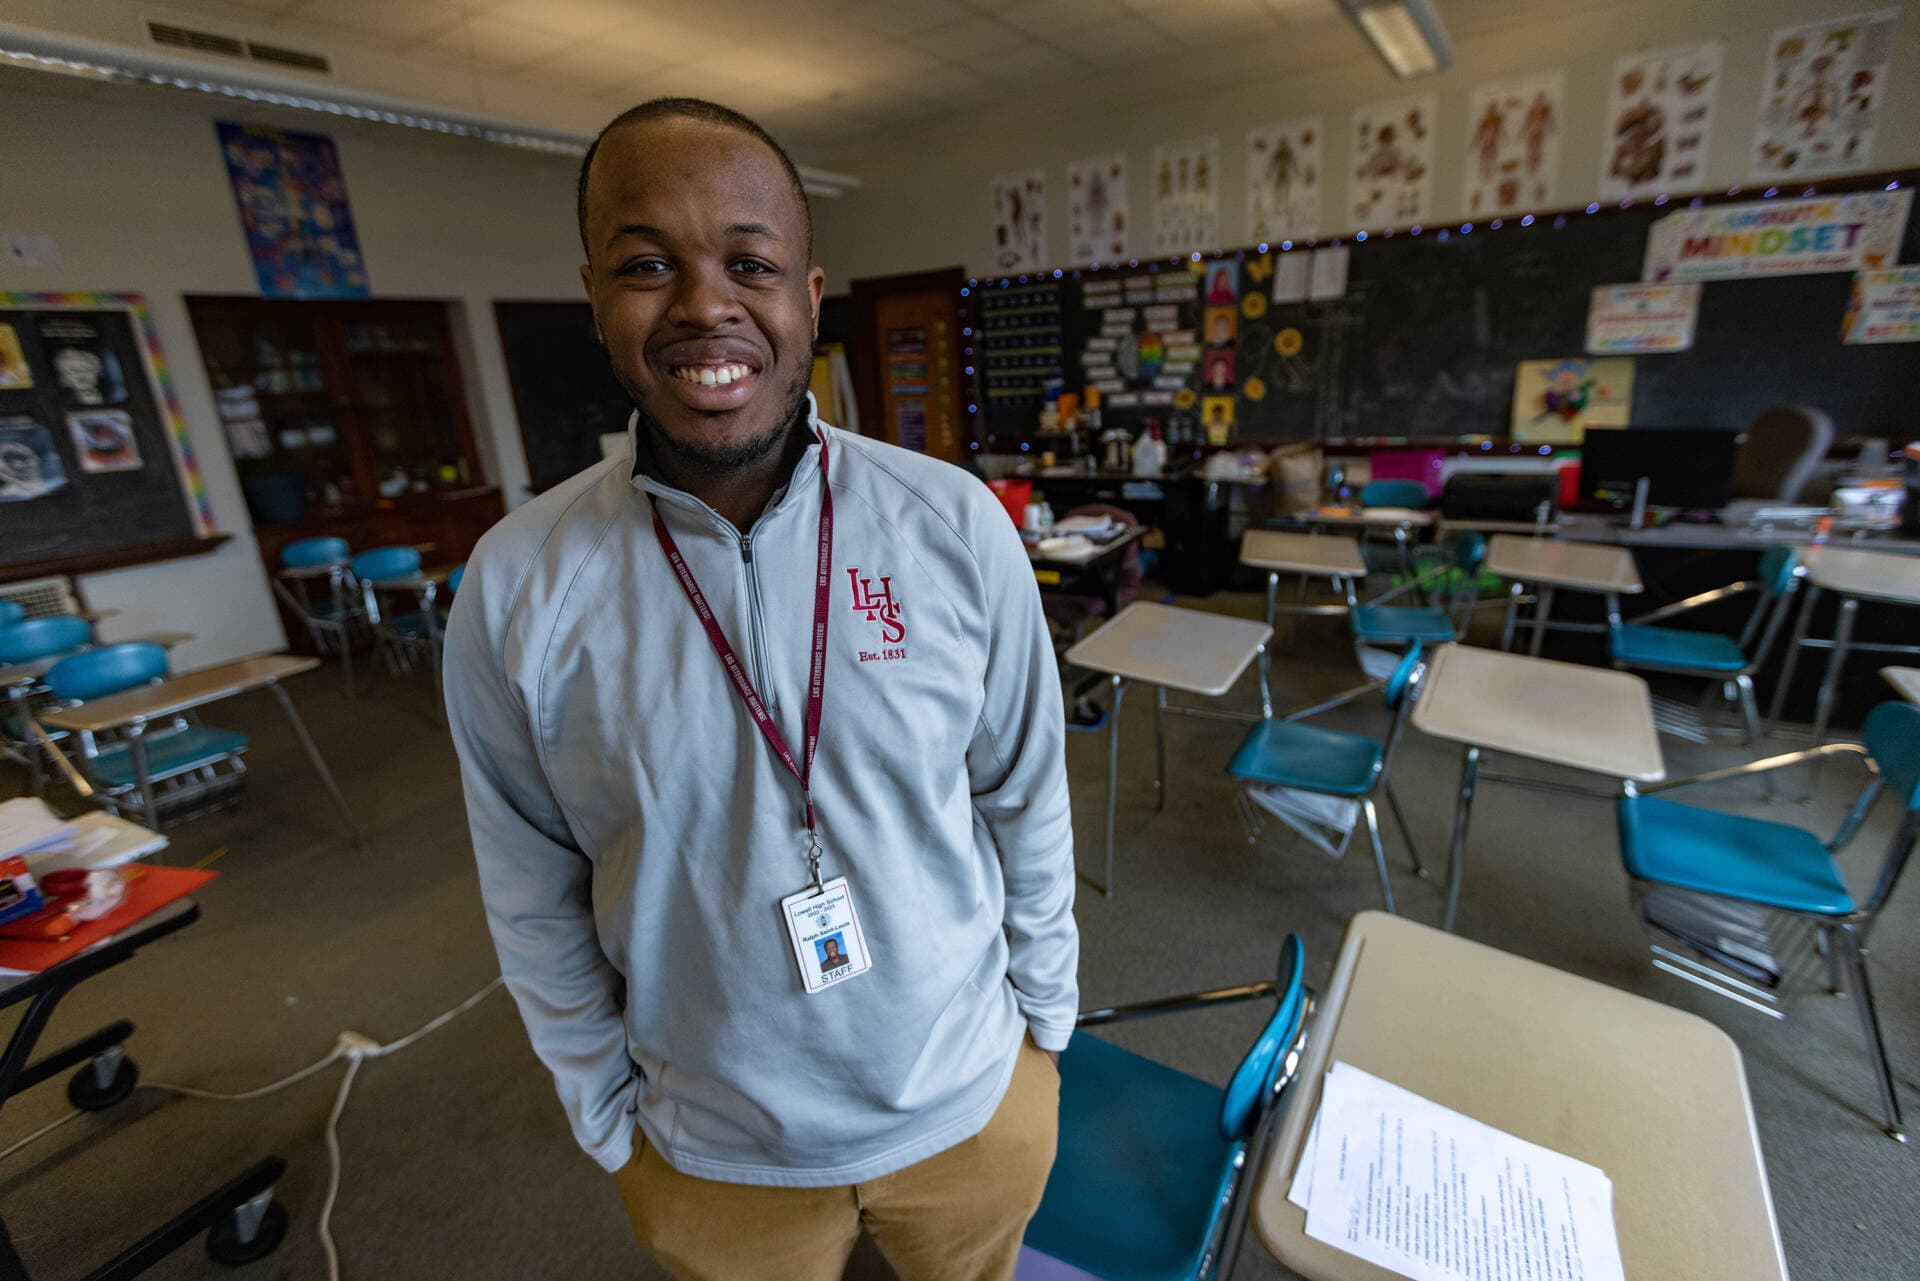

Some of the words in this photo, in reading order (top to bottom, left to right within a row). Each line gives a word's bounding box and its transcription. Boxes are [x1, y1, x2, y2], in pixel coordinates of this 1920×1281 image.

[1679, 222, 1865, 259] MINDSET
[845, 567, 906, 644] LHS
[858, 651, 880, 662] Est.
[882, 648, 907, 660] 1831
[812, 902, 826, 910] High
[821, 963, 853, 983] STAFF
